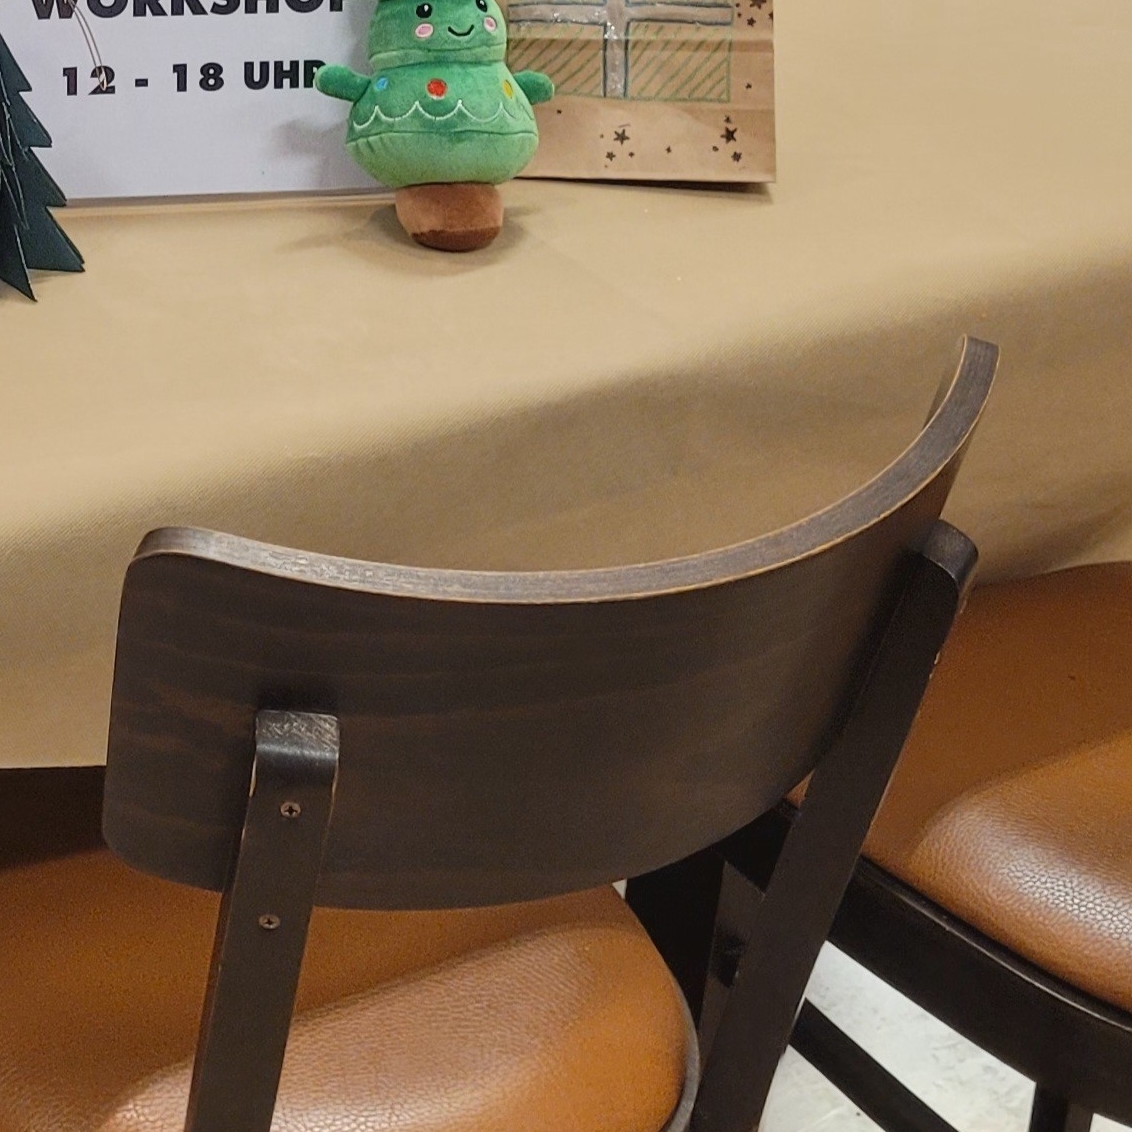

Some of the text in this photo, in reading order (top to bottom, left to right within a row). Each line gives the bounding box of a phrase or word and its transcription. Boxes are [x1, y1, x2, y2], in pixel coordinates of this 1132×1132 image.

[62, 65, 116, 96] 12
[135, 78, 149, 87] -
[172, 62, 225, 92] 18
